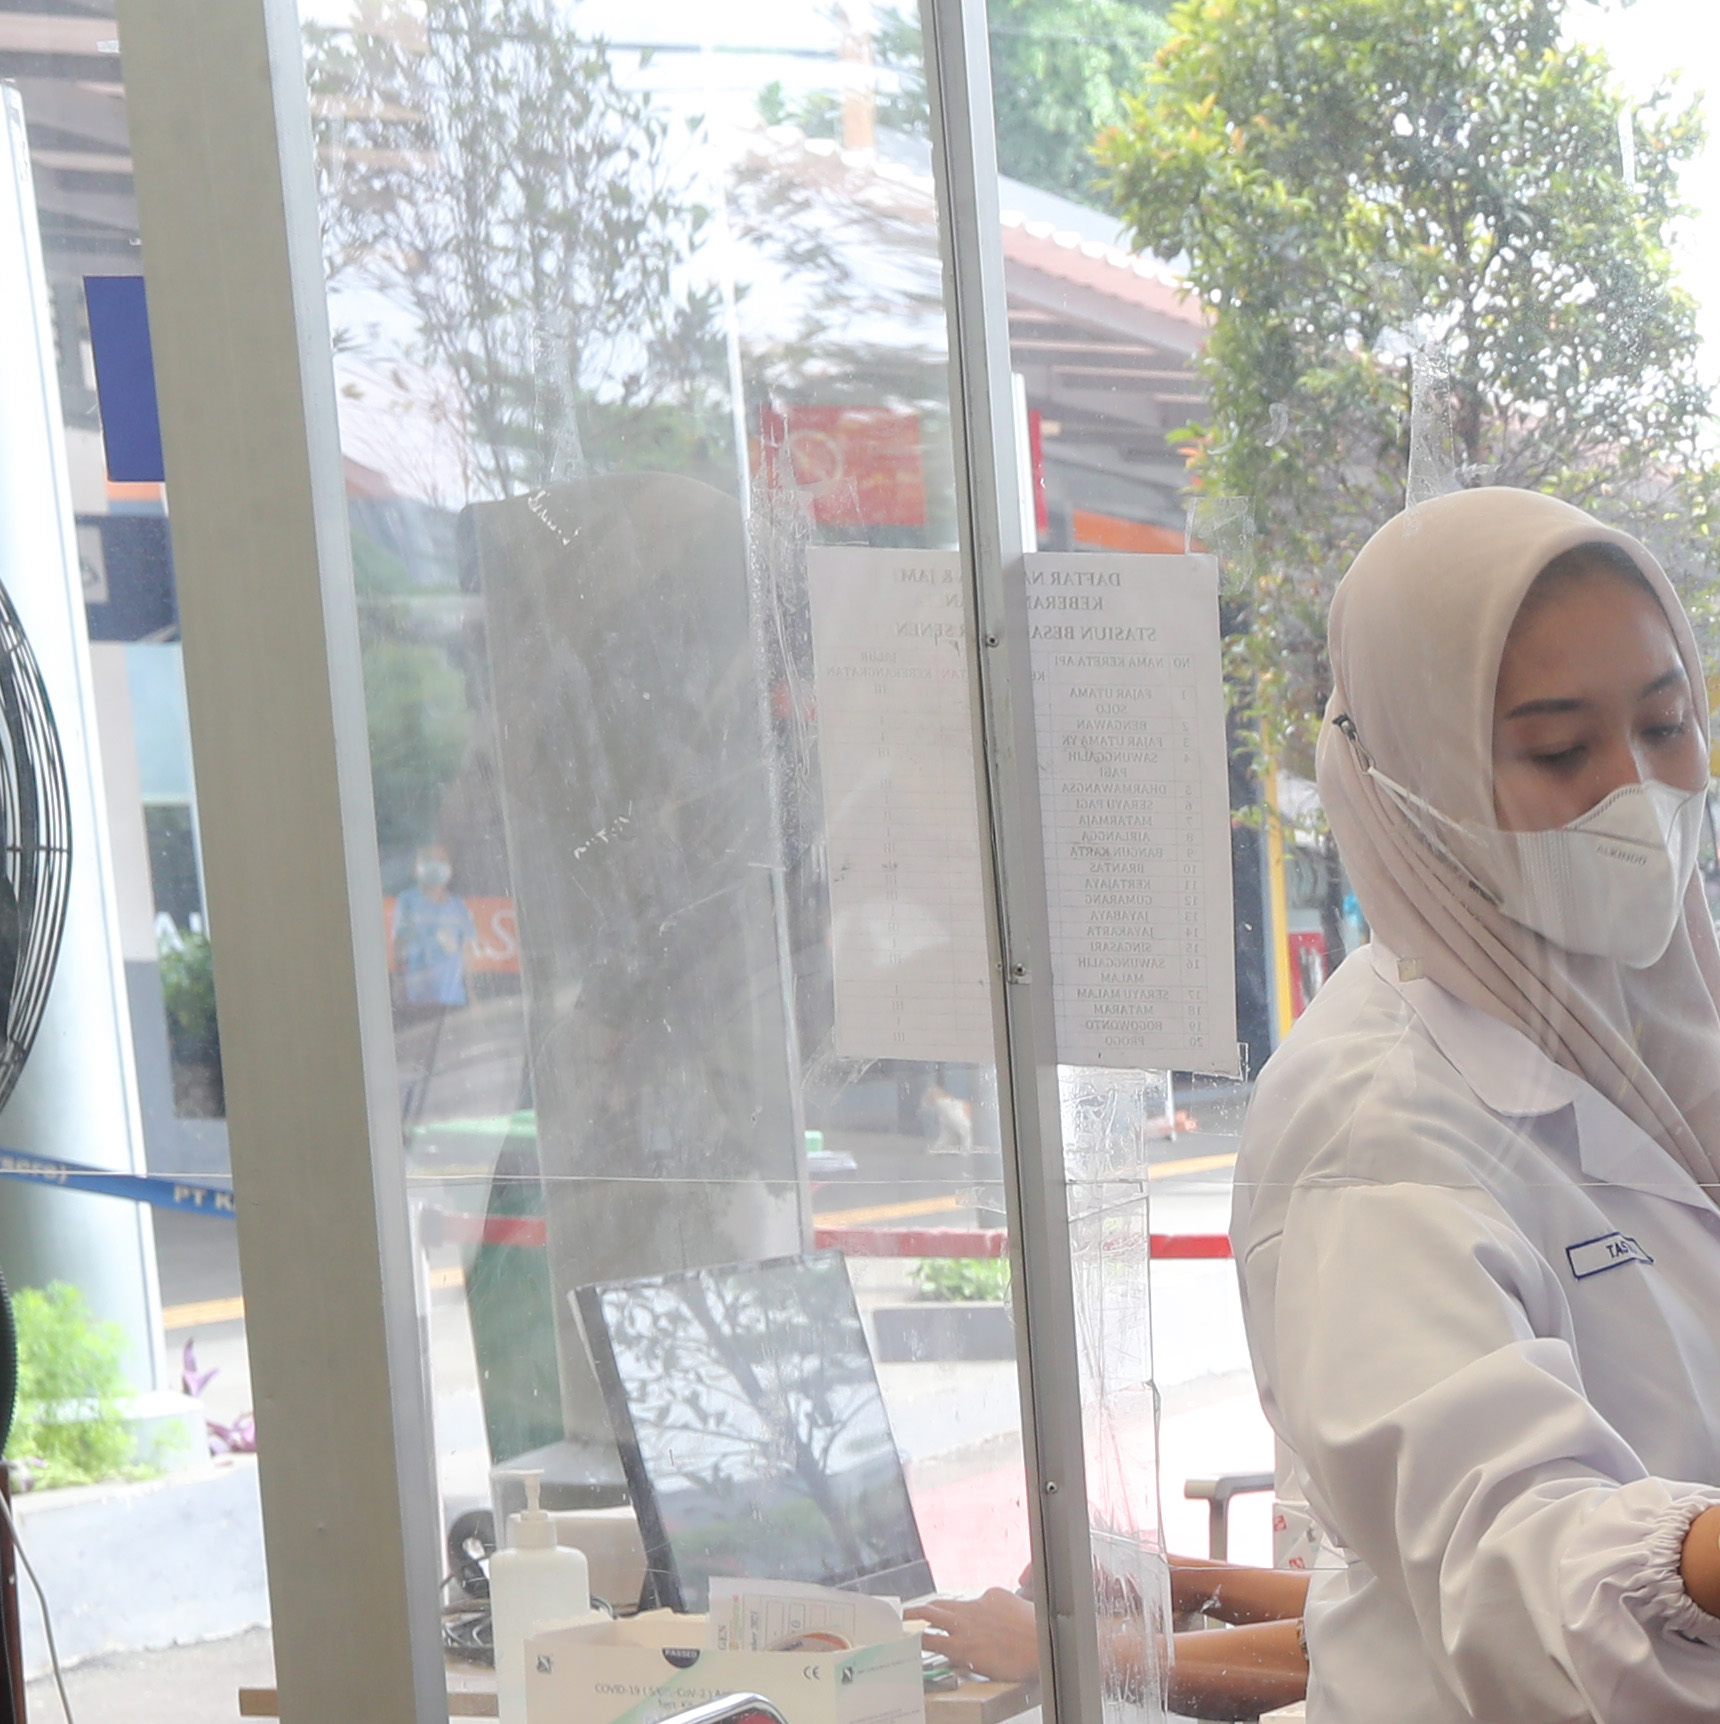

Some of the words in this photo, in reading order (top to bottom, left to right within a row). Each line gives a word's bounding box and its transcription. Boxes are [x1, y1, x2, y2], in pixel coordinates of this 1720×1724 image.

[173, 1185, 207, 1206] PT
[665, 1649, 698, 1657] PASSED
[595, 1683, 640, 1695] COVID-19
